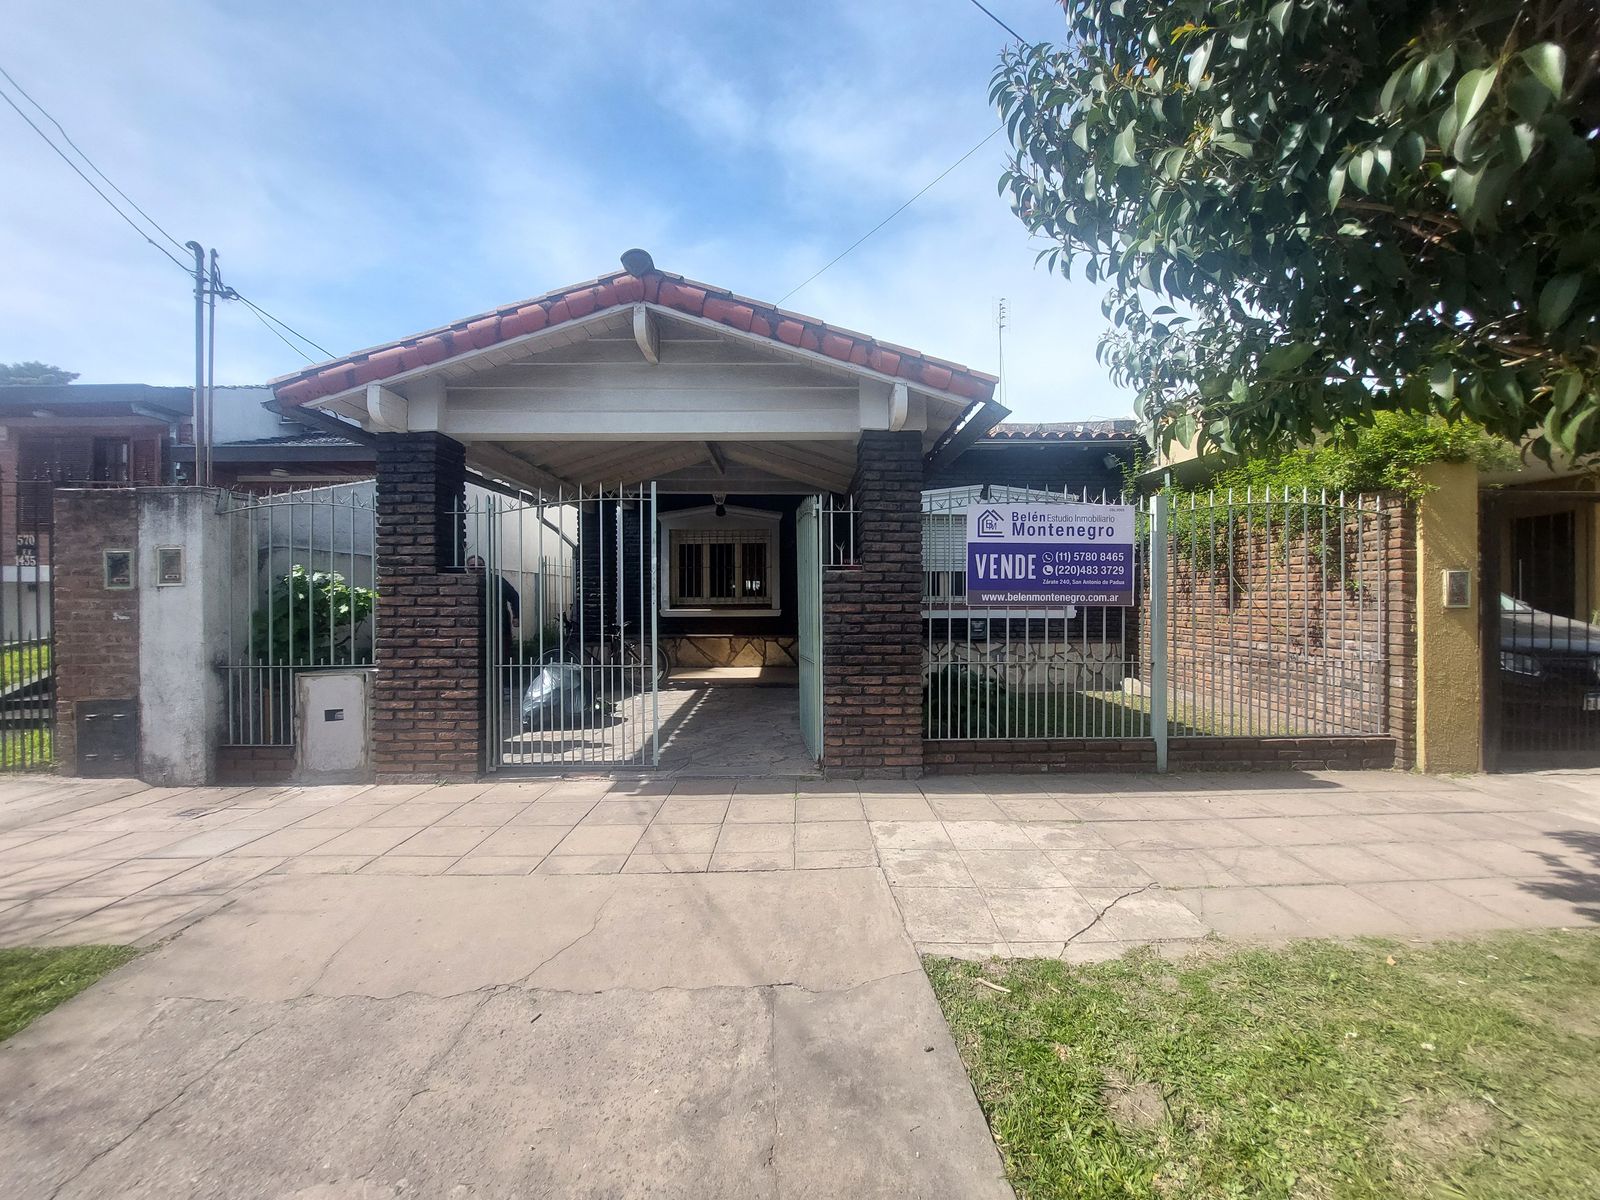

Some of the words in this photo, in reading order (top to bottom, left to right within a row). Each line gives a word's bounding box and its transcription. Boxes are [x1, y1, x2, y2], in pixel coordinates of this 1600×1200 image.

[1012, 511, 1046, 522] Belén
[1047, 513, 1073, 523] Estudio
[1074, 513, 1116, 523] Inmobiliario
[1012, 523, 1115, 540] Montenegro
[17, 534, 35, 546] 570
[15, 555, 37, 566] 1435
[1055, 551, 1071, 563] (11)
[1073, 552, 1098, 562] 5780
[1100, 552, 1125, 562] 8465
[975, 553, 1037, 580] VENDE
[1100, 566, 1125, 576] 3729
[981, 592, 1119, 604] www.belenmontenegro.com.ar
